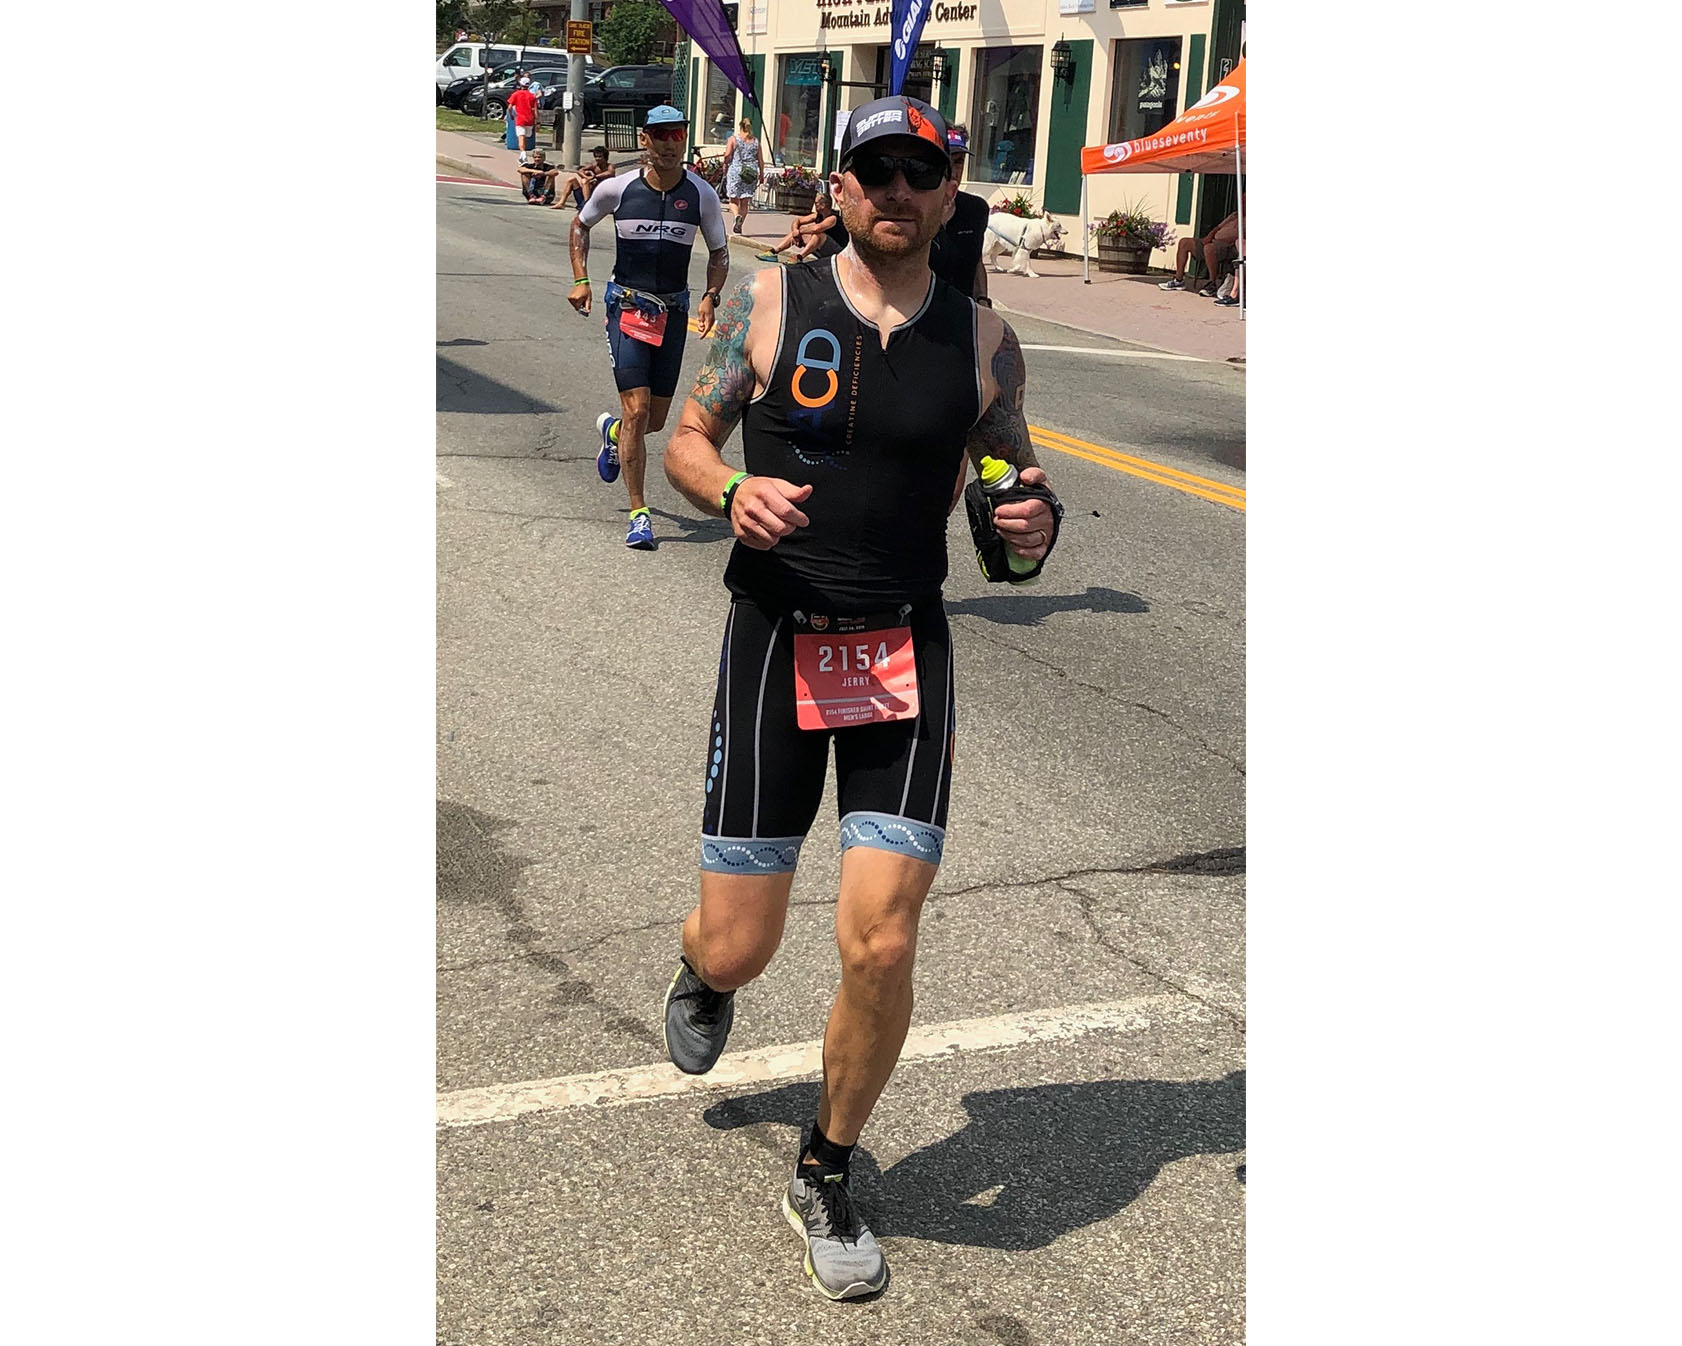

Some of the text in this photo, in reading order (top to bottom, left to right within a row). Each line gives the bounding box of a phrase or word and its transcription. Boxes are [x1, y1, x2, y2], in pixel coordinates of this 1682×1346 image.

[820, 10, 870, 29] Mountain
[936, 3, 977, 22] Center
[1133, 127, 1208, 154] blueseventy
[636, 224, 686, 236] NRG
[850, 335, 863, 397] DEFICIENCIES
[819, 642, 890, 672] 2154
[842, 677, 870, 687] JERRY
